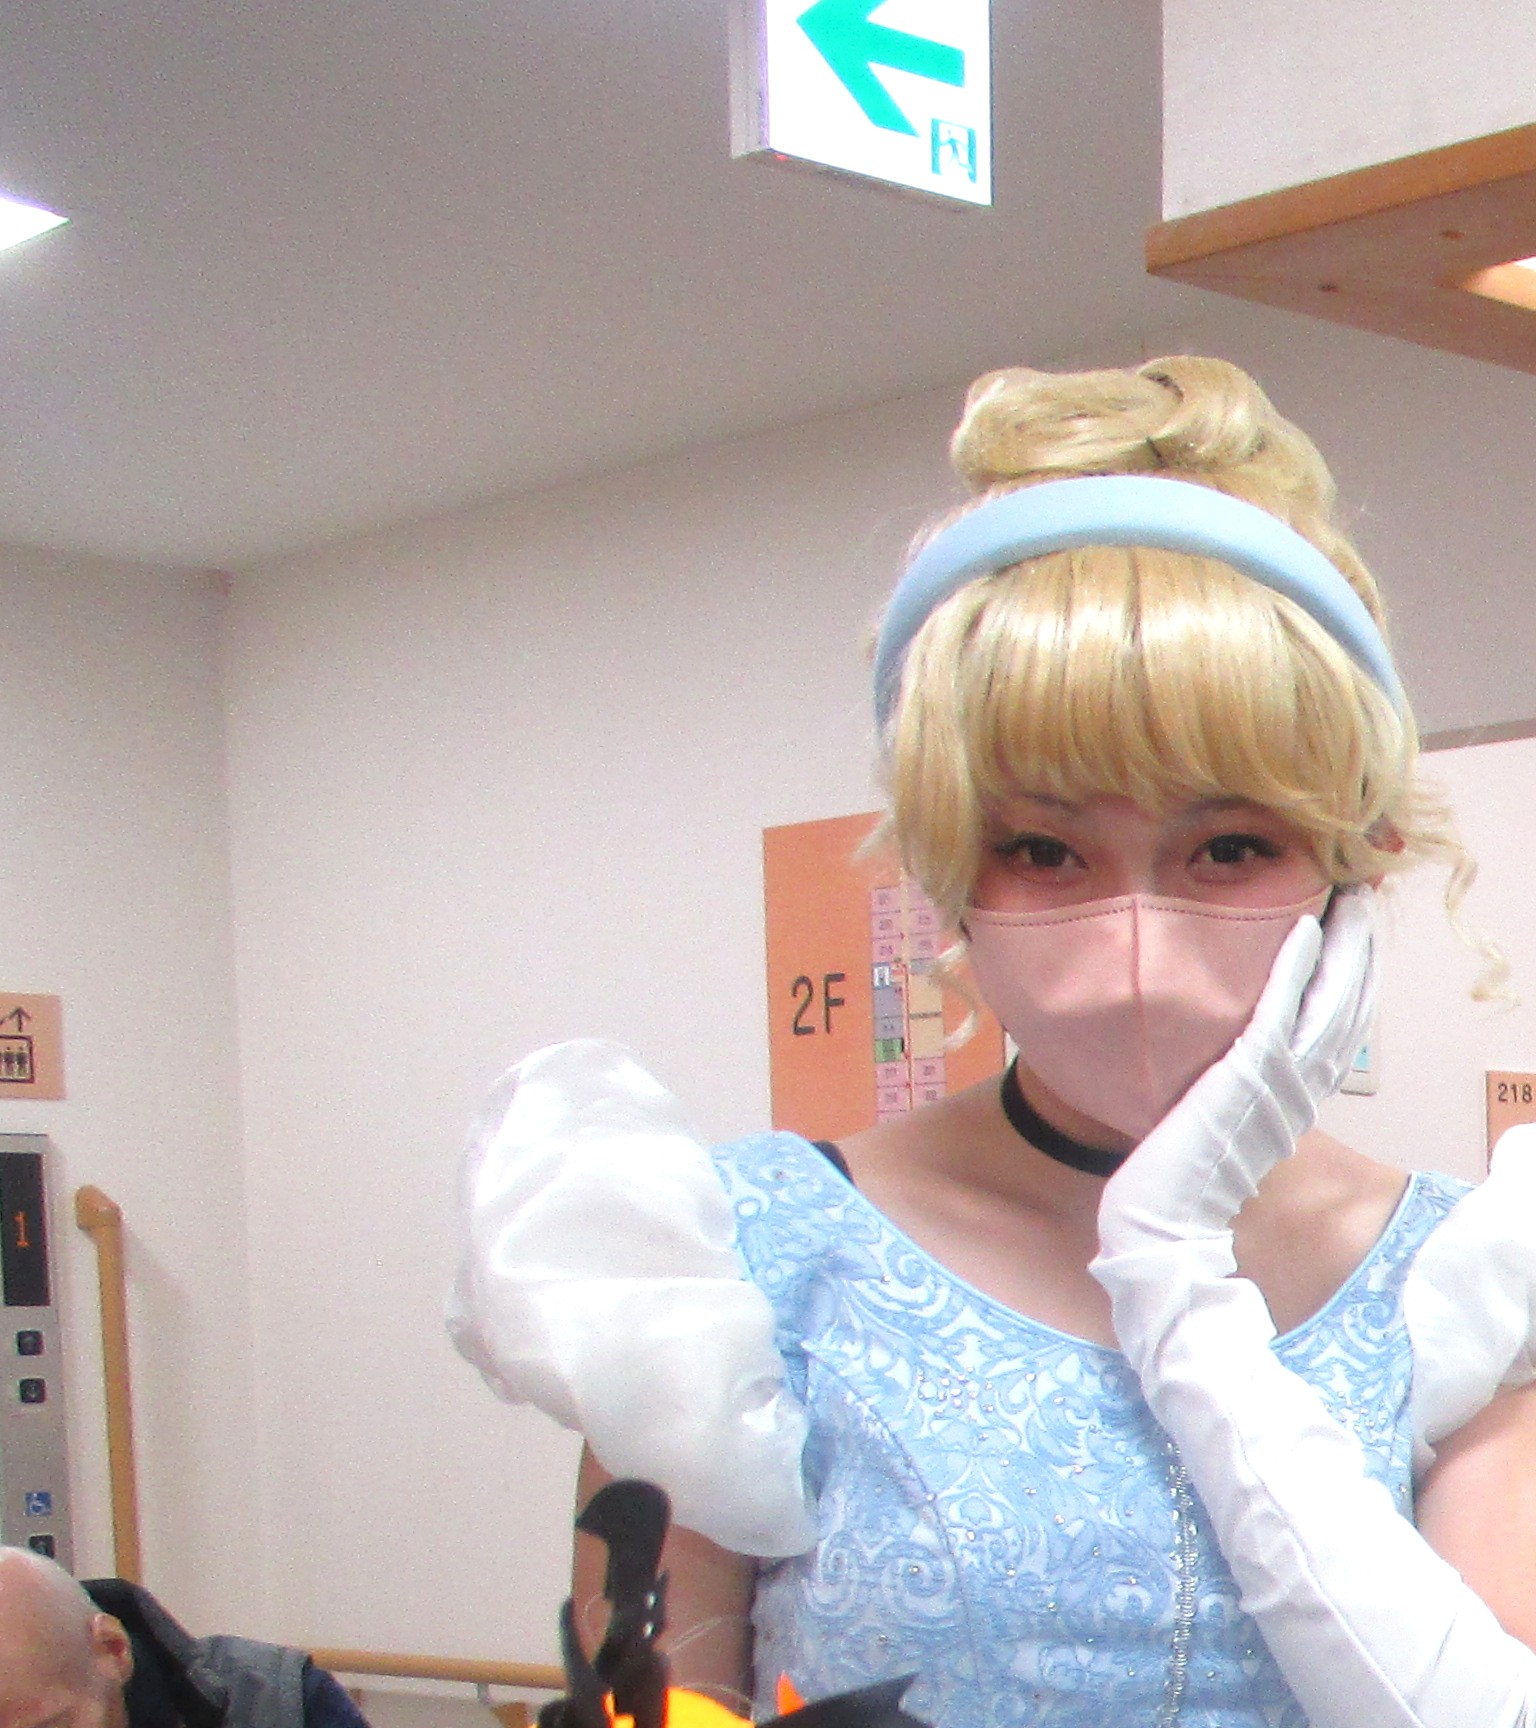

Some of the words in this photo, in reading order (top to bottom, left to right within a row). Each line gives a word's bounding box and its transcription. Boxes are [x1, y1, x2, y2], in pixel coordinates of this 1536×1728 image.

[791, 973, 845, 1036] 2F
[1497, 1083, 1533, 1105] 218
[15, 1211, 31, 1248] 1
